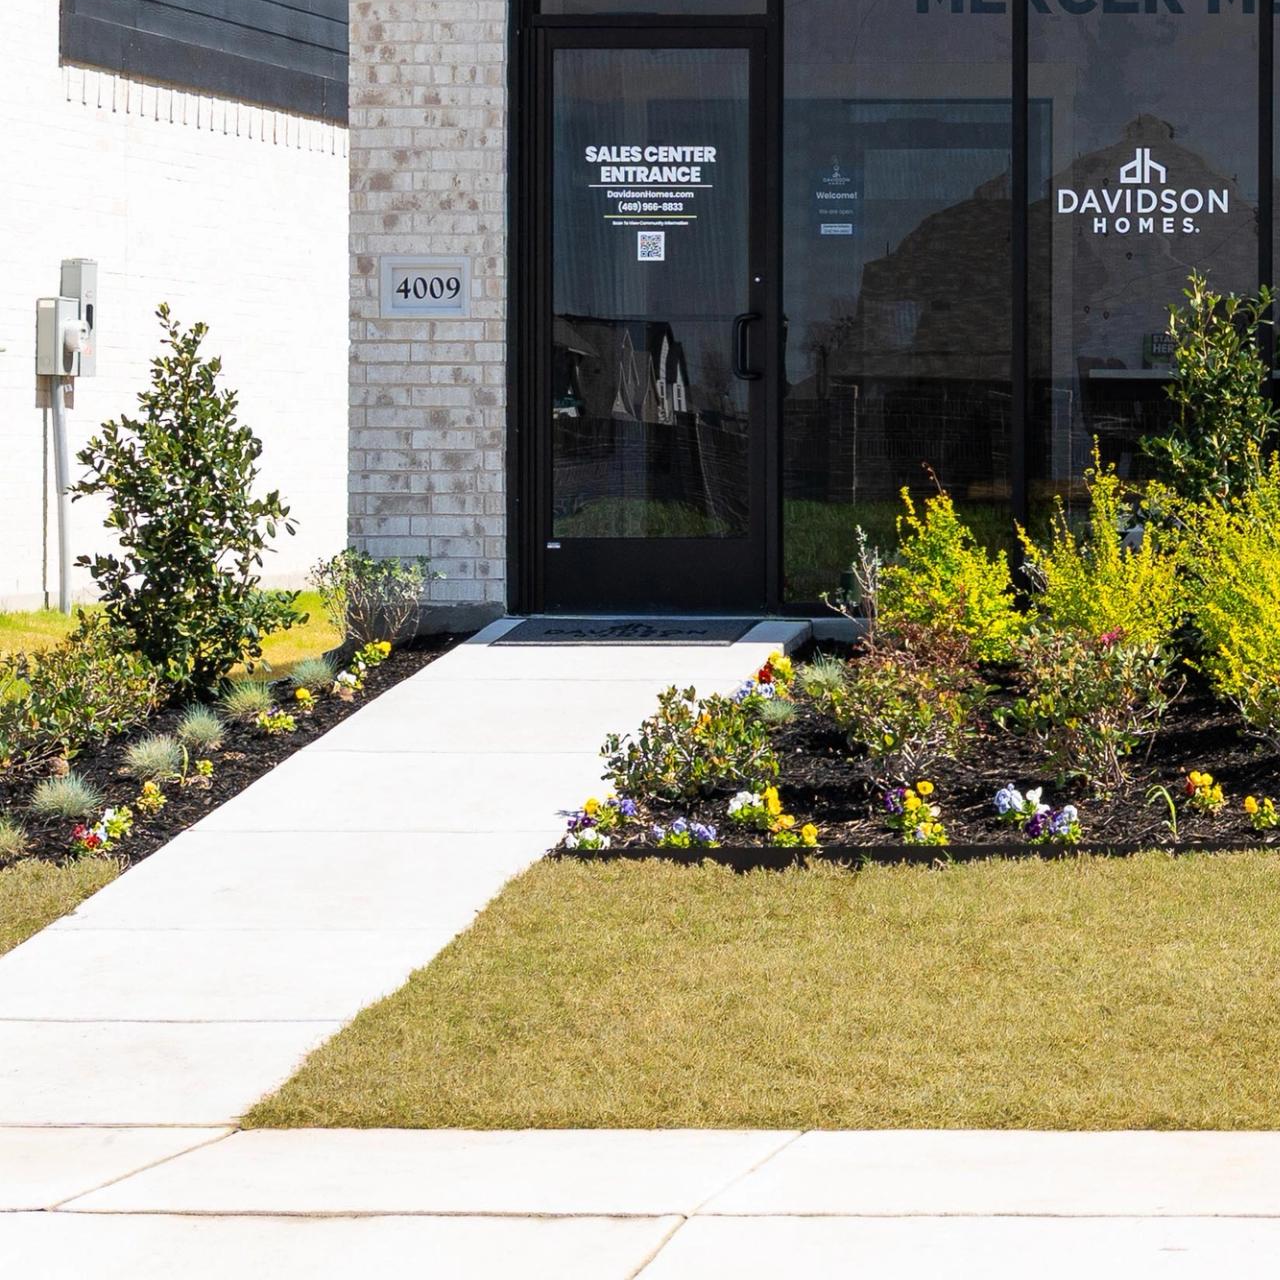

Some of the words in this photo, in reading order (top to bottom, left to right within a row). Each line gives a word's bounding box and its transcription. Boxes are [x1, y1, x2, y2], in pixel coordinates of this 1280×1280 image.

[585, 145, 642, 162] SALES
[643, 145, 717, 162] CENTER
[600, 166, 701, 182] ENTRANCE
[1057, 188, 1229, 214] DAVIDSON
[396, 276, 461, 300] 4009
